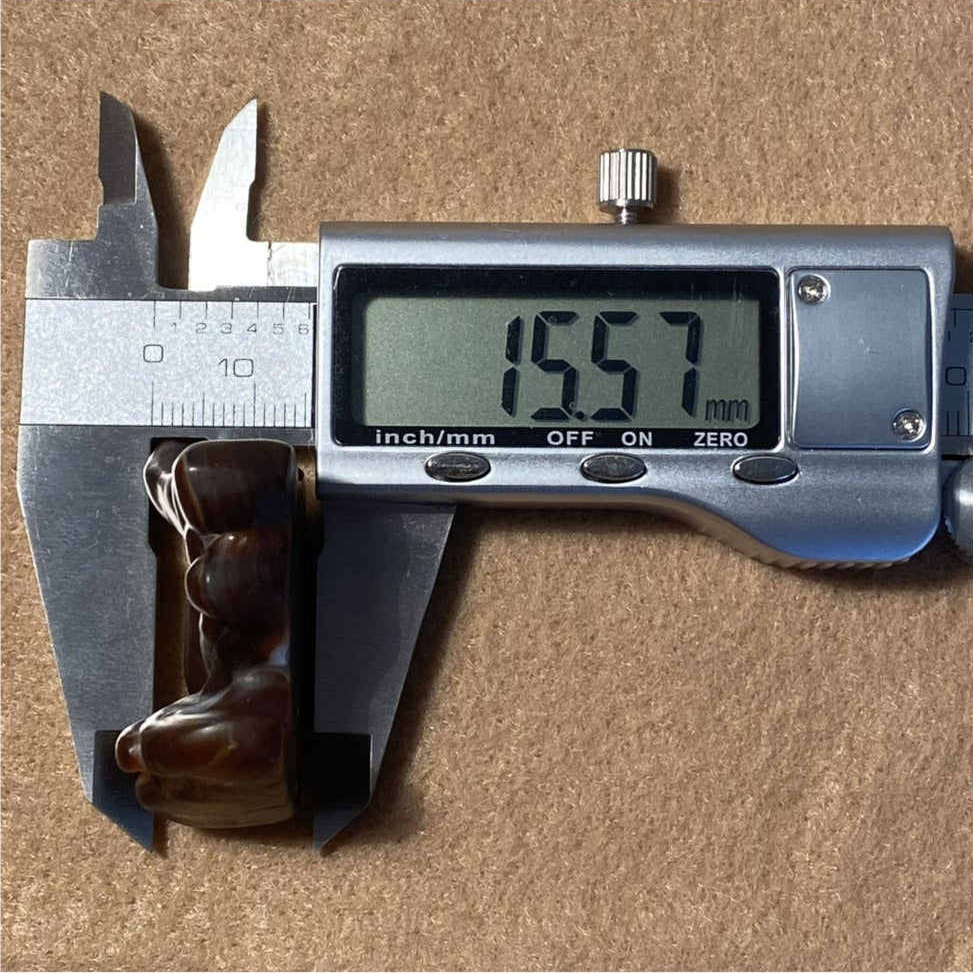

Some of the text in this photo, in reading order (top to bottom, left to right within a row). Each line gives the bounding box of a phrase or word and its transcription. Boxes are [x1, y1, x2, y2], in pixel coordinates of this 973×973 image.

[171, 323, 309, 335] 1 2 3 4 5 6
[143, 344, 254, 377] 0 10
[501, 311, 749, 423] 15.57 mm
[375, 429, 748, 446] inch/mm OFF ON ZERO
